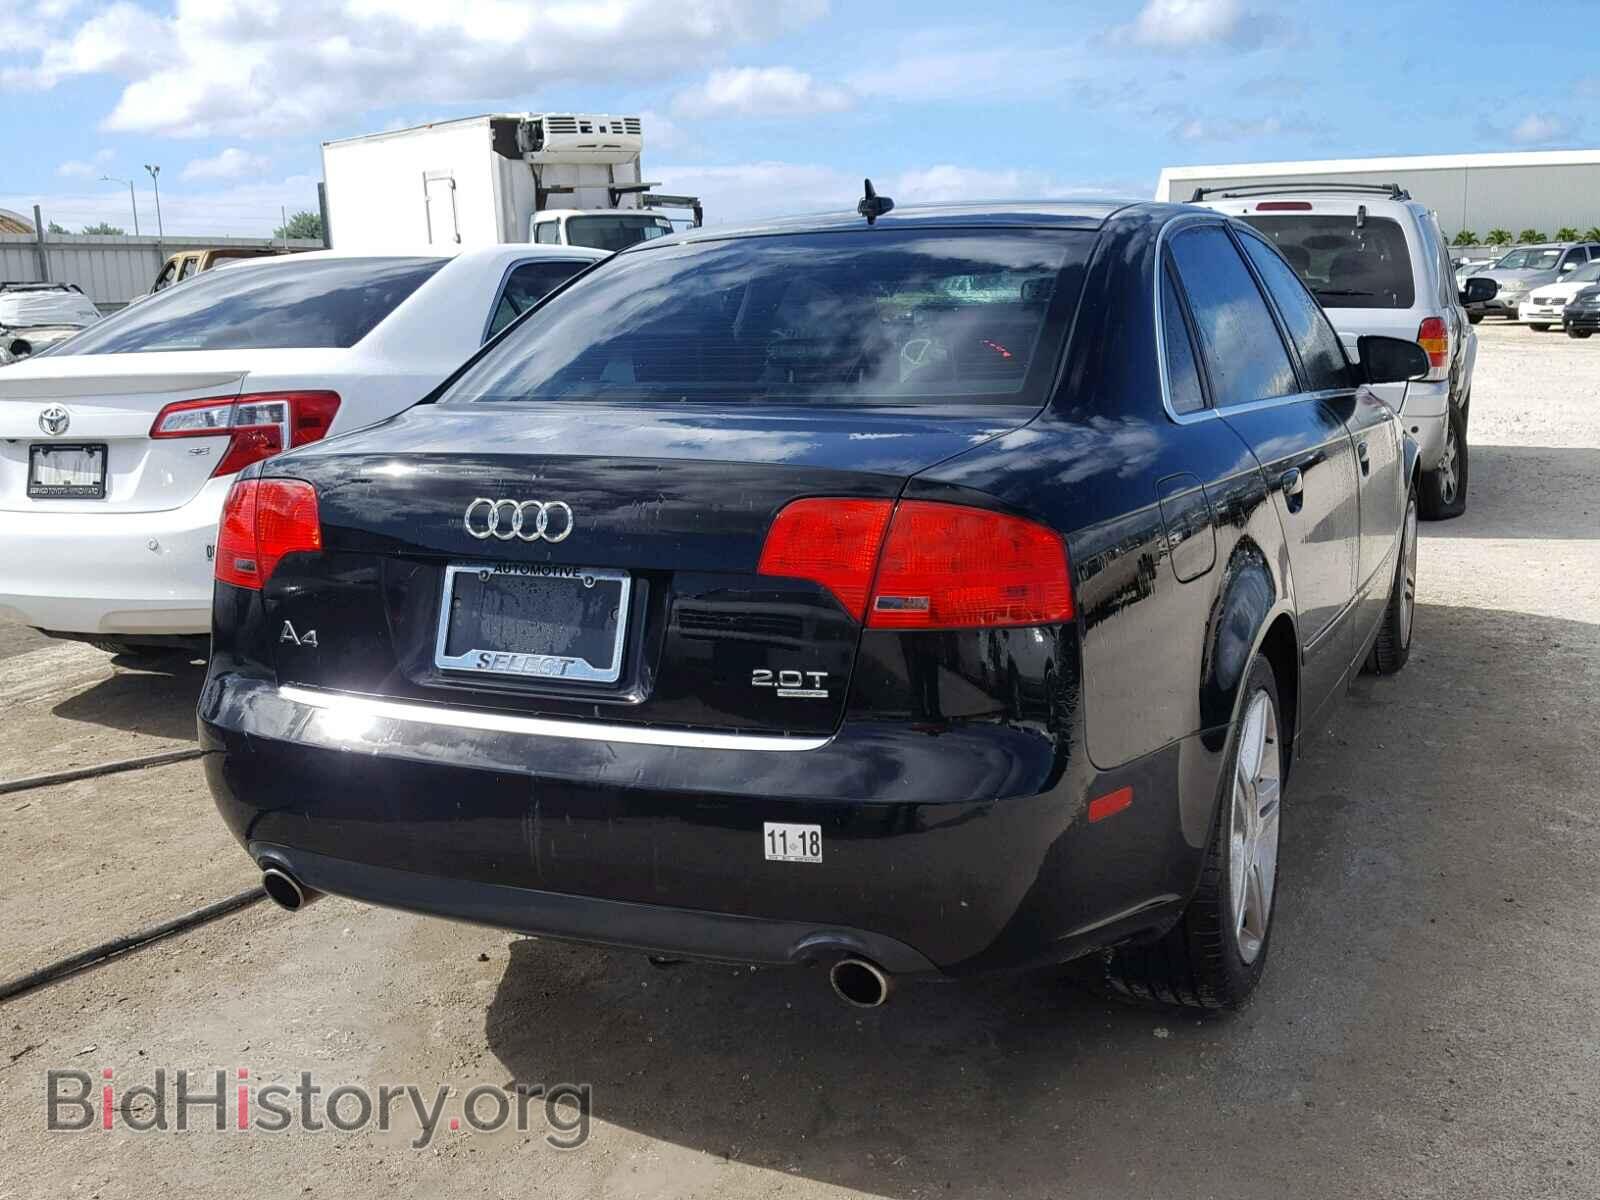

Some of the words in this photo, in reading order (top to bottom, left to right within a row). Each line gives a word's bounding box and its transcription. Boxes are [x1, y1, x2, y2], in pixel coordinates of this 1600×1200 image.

[493, 563, 582, 578] AUTOMOTIVE
[280, 620, 319, 648] A4
[476, 652, 576, 677] SELECT
[751, 669, 829, 688] 2.0T
[767, 829, 788, 855] 11
[798, 830, 820, 857] 18
